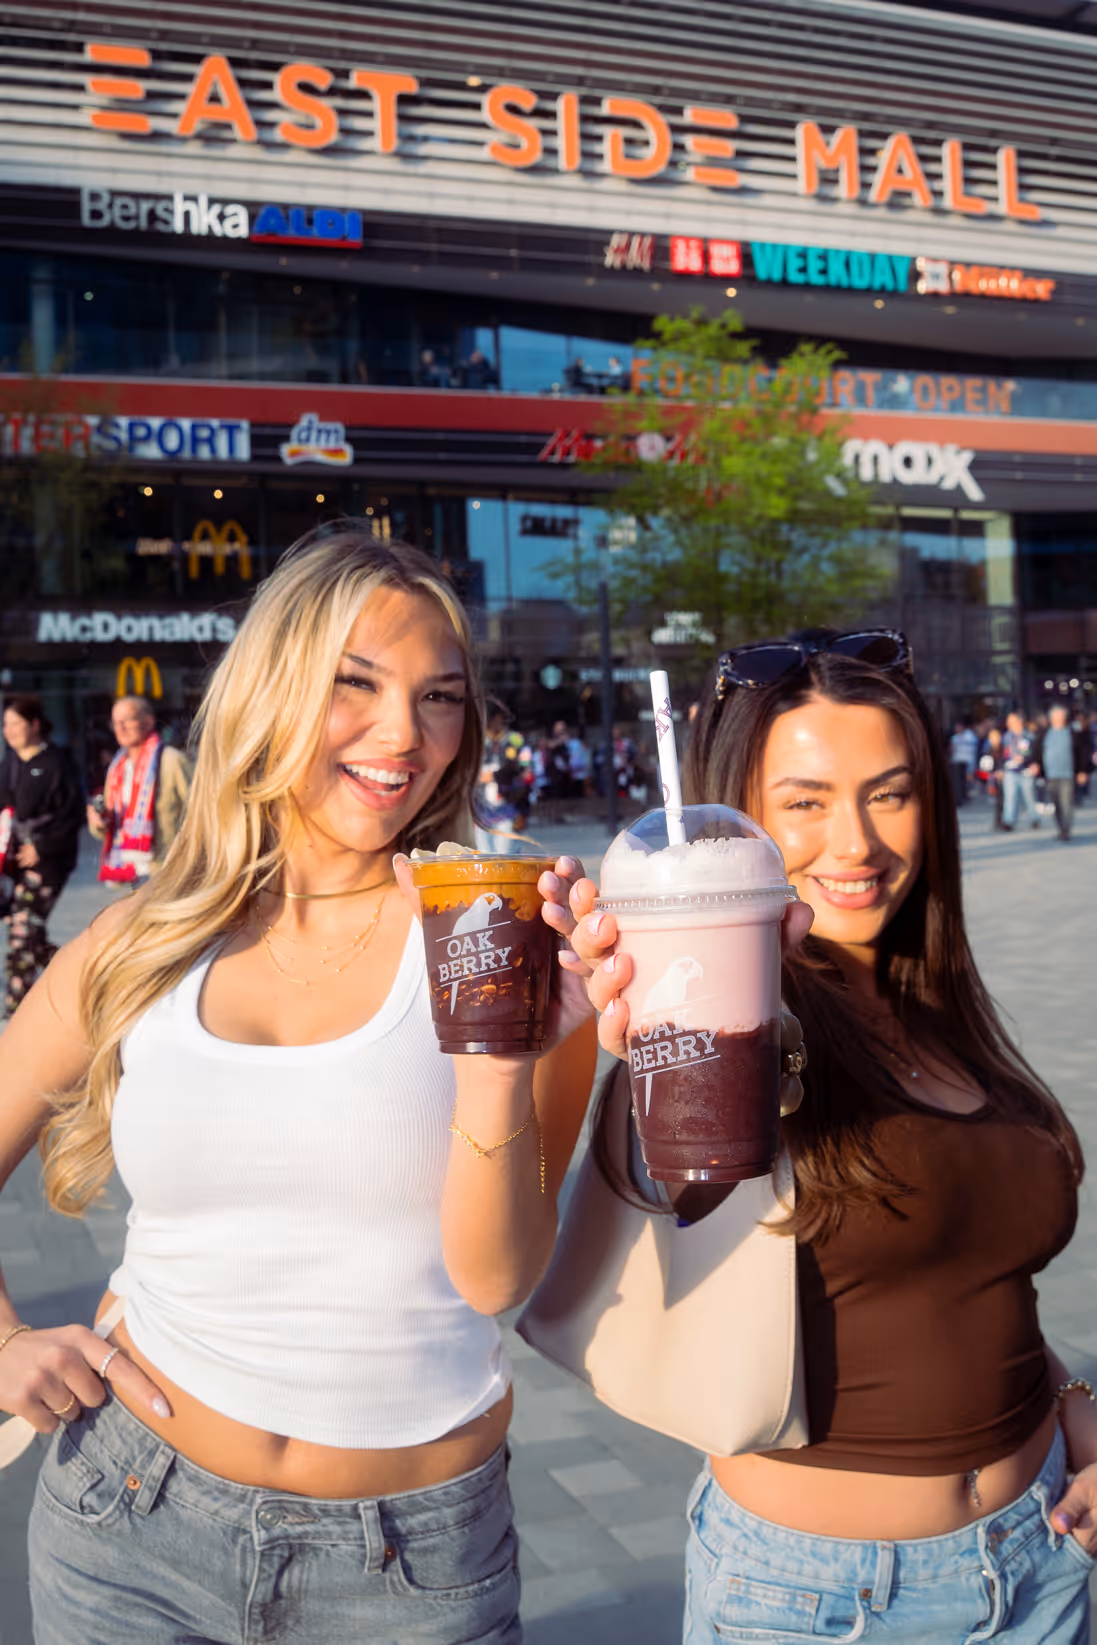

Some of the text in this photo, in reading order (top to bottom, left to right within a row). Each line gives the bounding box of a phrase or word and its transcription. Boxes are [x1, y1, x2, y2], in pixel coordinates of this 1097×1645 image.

[86, 43, 1042, 220] EAST SIDE MALL
[80, 187, 250, 239] Bershka
[252, 205, 363, 241] ALDI
[750, 241, 912, 293] WEEKDAY
[913, 375, 1012, 414] OPEN
[841, 438, 985, 502] maxx
[38, 611, 237, 643] McDonald's
[438, 946, 512, 983] BERRY
[446, 930, 495, 958] OAK
[631, 1029, 720, 1073] BERRY
